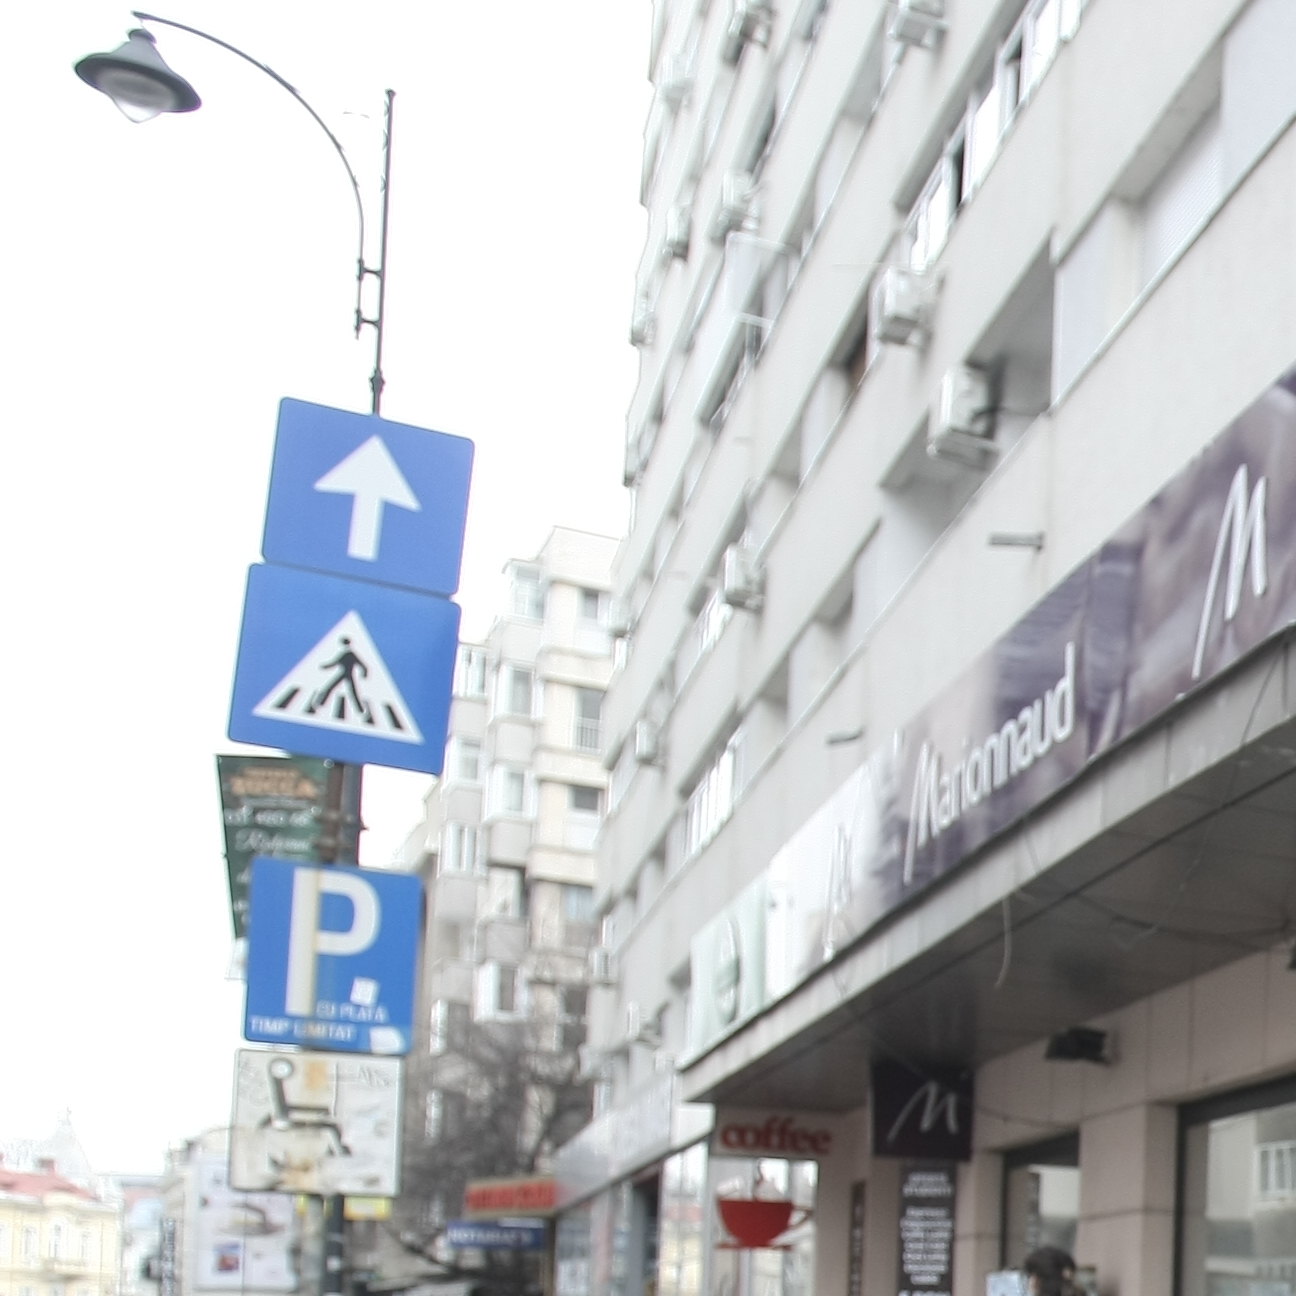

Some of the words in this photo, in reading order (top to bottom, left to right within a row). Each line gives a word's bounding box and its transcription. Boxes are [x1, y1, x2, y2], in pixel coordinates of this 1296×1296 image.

[903, 641, 1076, 887] Marionnaud
[285, 867, 381, 1016] P
[721, 1115, 832, 1155] coffee
